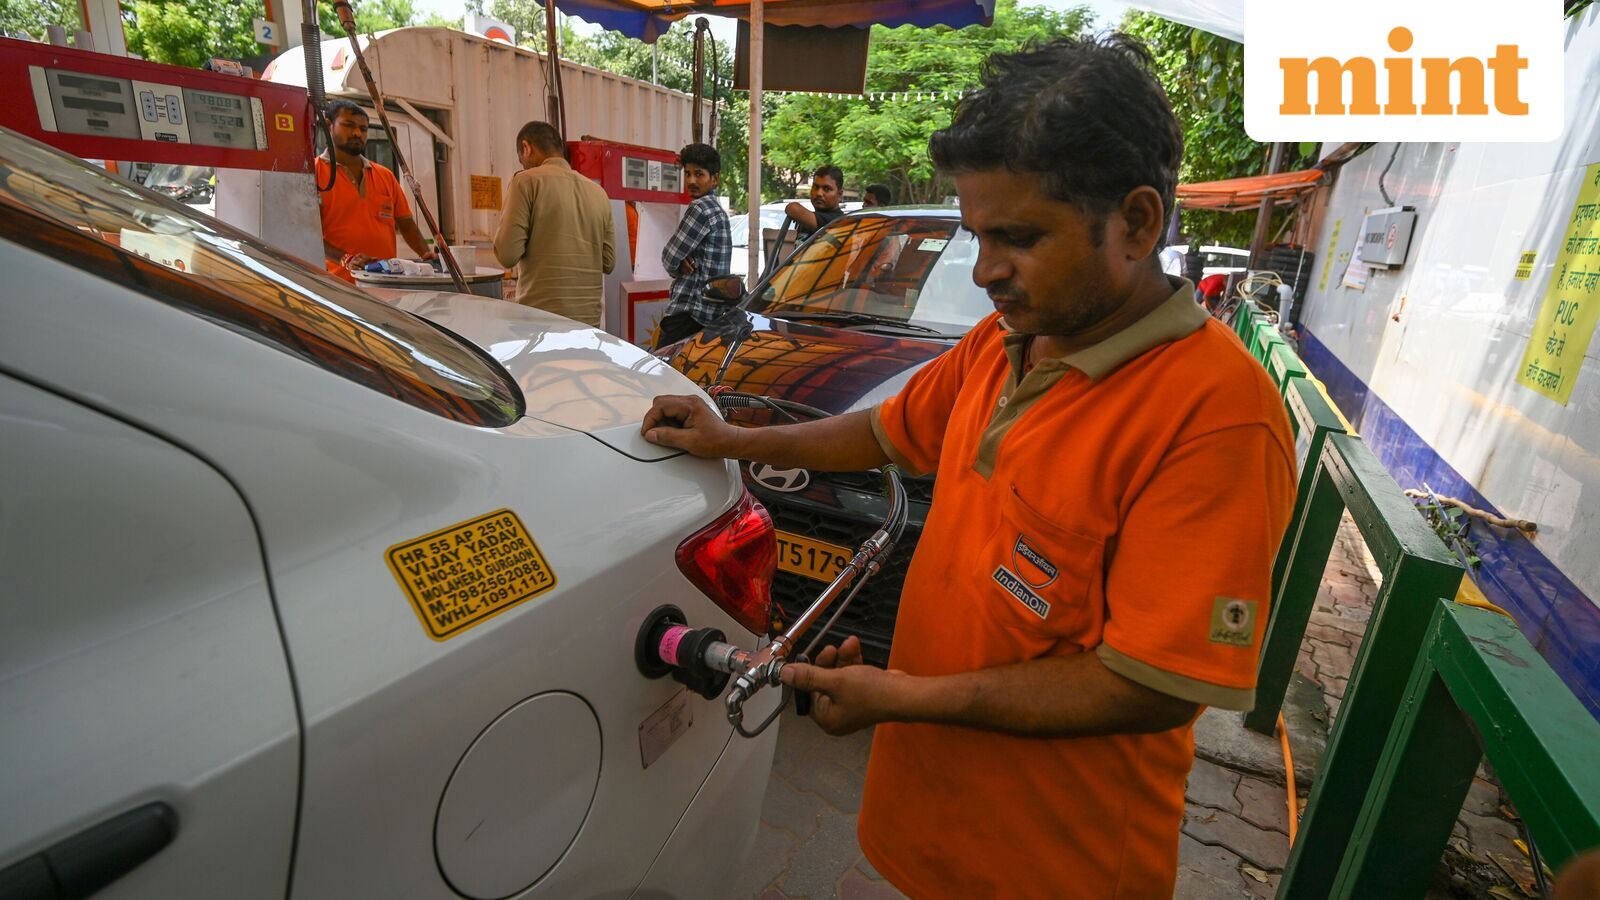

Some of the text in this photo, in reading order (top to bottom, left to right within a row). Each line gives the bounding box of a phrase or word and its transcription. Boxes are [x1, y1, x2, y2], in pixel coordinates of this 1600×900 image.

[262, 26, 273, 39] 2
[1554, 299, 1578, 326] PUC
[399, 516, 513, 566] HR 55 AP 2518
[406, 526, 518, 577] VIJAY YADAV
[413, 537, 528, 590] H NO-82 1ST-FLOOR
[777, 539, 847, 577] T5179
[420, 548, 535, 603] MOLAHERA GURGAON
[427, 559, 541, 617] M-7982562088
[996, 569, 1047, 616] IndianOil
